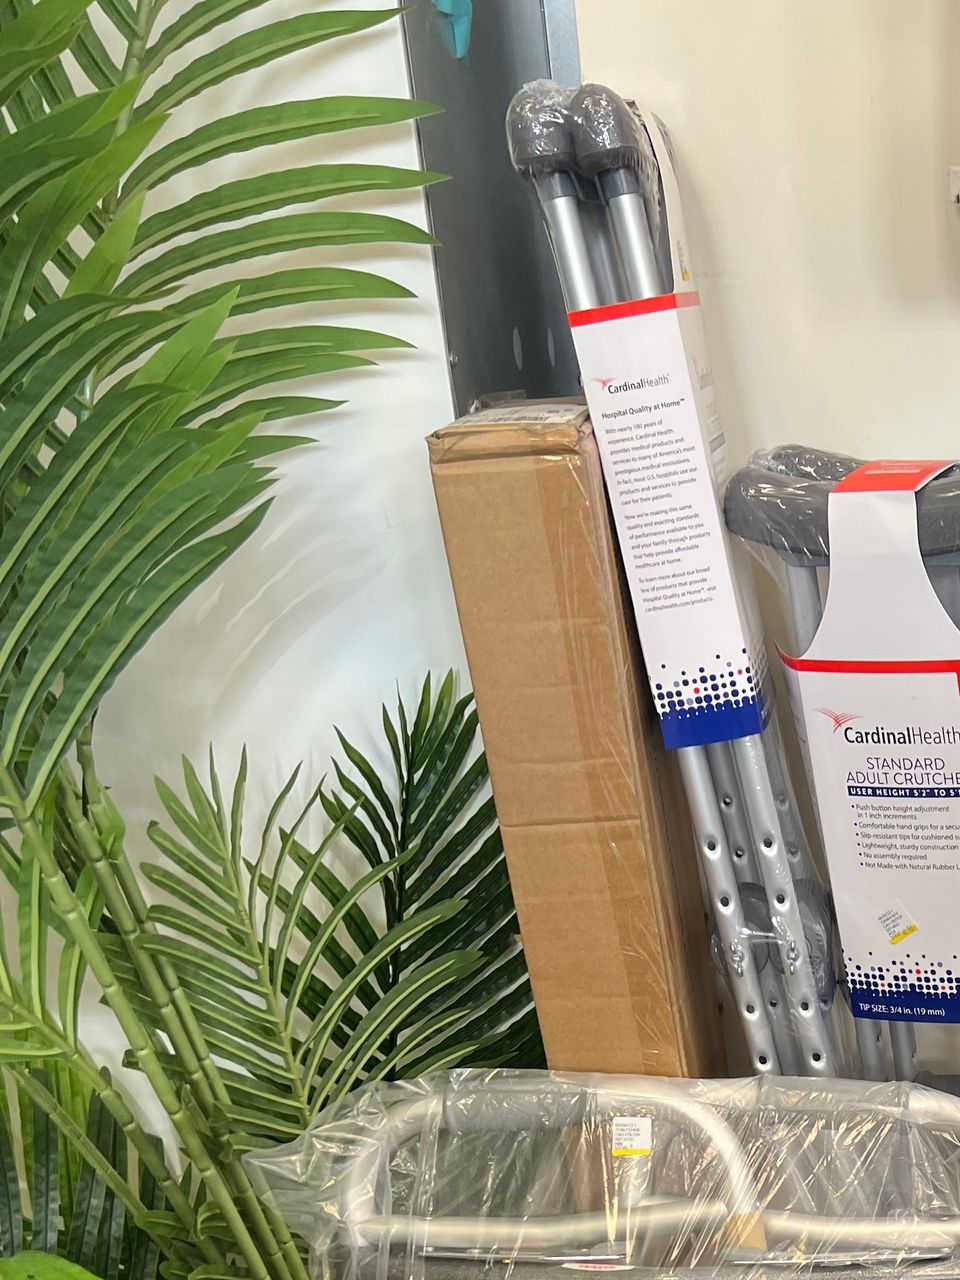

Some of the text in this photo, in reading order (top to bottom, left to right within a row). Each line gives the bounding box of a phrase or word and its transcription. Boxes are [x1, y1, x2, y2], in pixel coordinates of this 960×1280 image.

[601, 408, 628, 420] Hospital
[628, 405, 652, 415] Quality
[653, 403, 660, 411] at
[866, 757, 945, 771] STANDARD
[846, 771, 890, 785] ADULT
[850, 787, 873, 795] USER
[876, 788, 910, 796] HEIGHT
[856, 804, 950, 814] Push button height adjustment
[858, 822, 895, 830] Comfortable
[896, 822, 912, 830] hand
[913, 824, 929, 832] grips
[899, 832, 910, 841] tips
[921, 833, 953, 841] cushioned
[899, 843, 919, 852] sturdy
[919, 843, 959, 851] construction
[873, 853, 900, 861] assembly
[901, 854, 927, 862] required
[932, 863, 955, 871] Rubber
[859, 1003, 946, 1016] TIP SIZE: 3/4 in. (19 mm)
